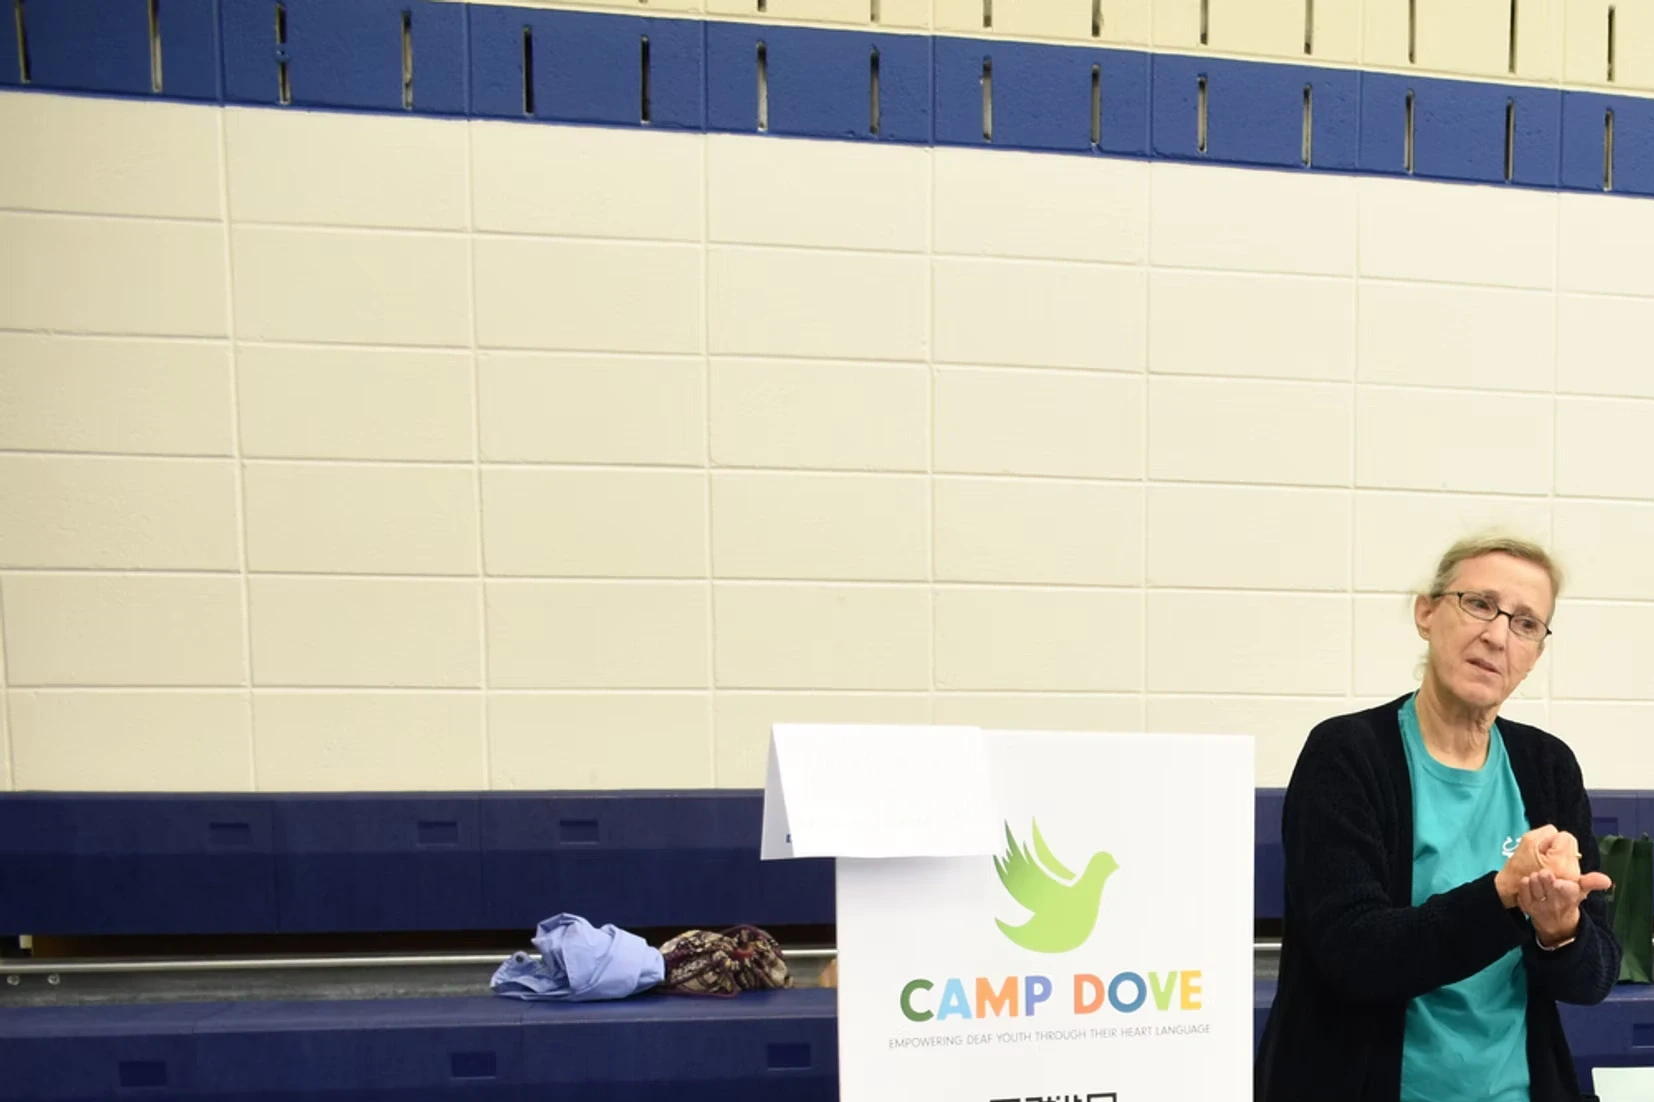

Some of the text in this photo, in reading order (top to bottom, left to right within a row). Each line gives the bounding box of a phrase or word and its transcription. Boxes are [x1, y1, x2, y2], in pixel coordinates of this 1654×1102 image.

[899, 969, 1203, 1023] CAMP DOVE
[888, 1023, 1212, 1049] EMPOWERING DEAF YOUTH THROUGH THEIR HEART LANGUAGE
